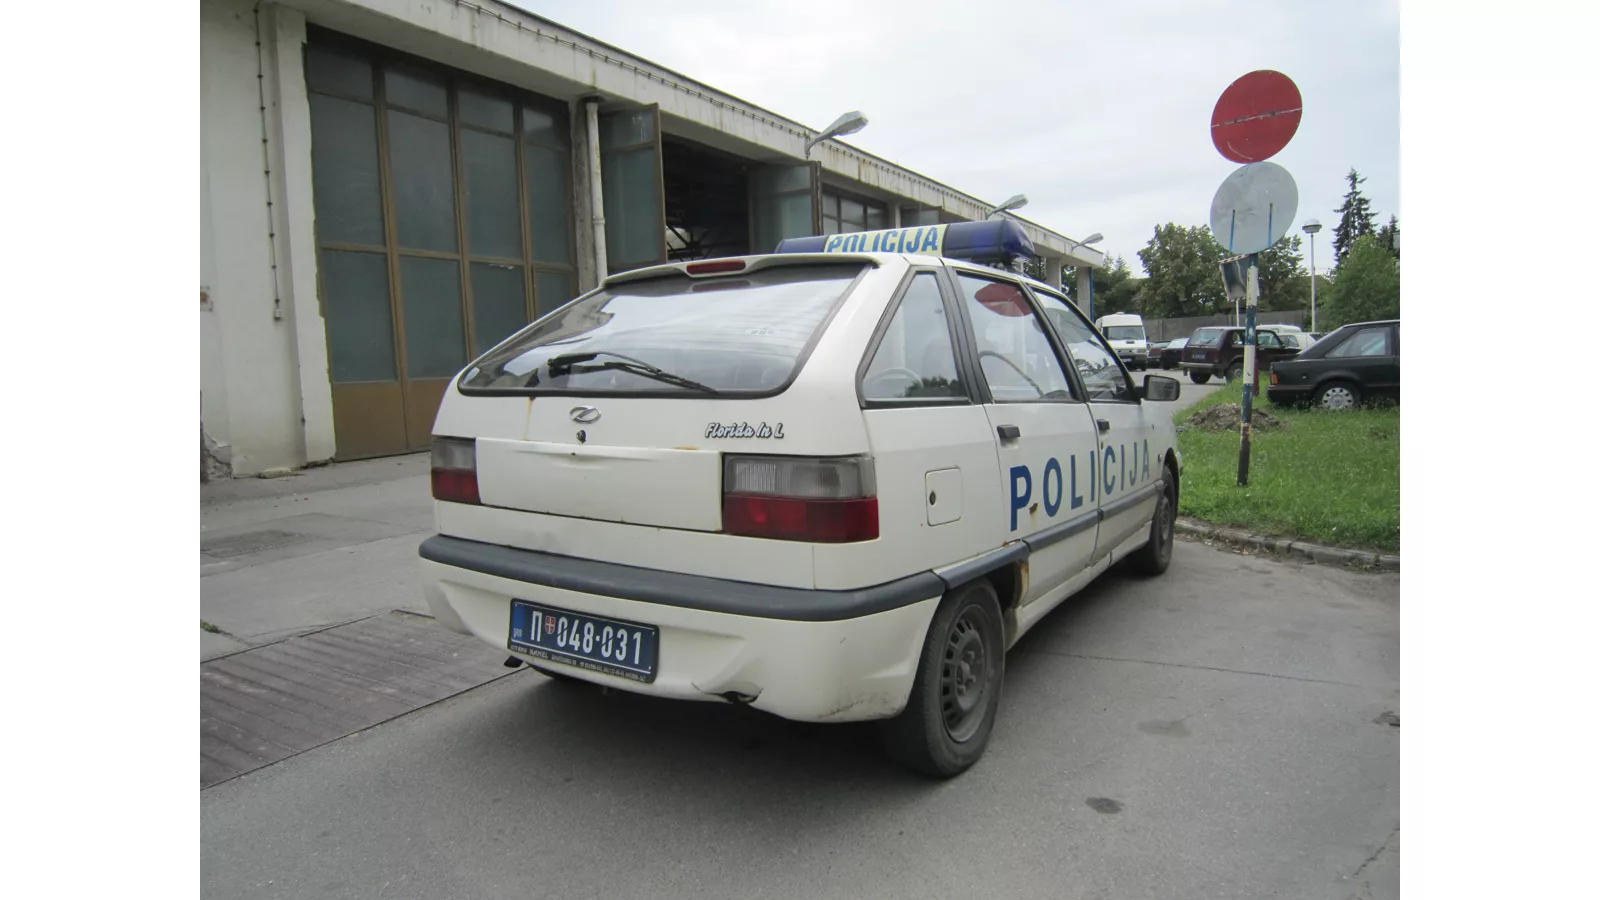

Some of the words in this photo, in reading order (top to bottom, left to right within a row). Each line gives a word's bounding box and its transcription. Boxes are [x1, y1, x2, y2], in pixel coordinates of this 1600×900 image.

[827, 226, 938, 254] POLICIJA
[704, 421, 756, 439] Florida
[756, 421, 773, 439] In
[774, 422, 785, 439] L
[1009, 438, 1151, 532] POLICIJA
